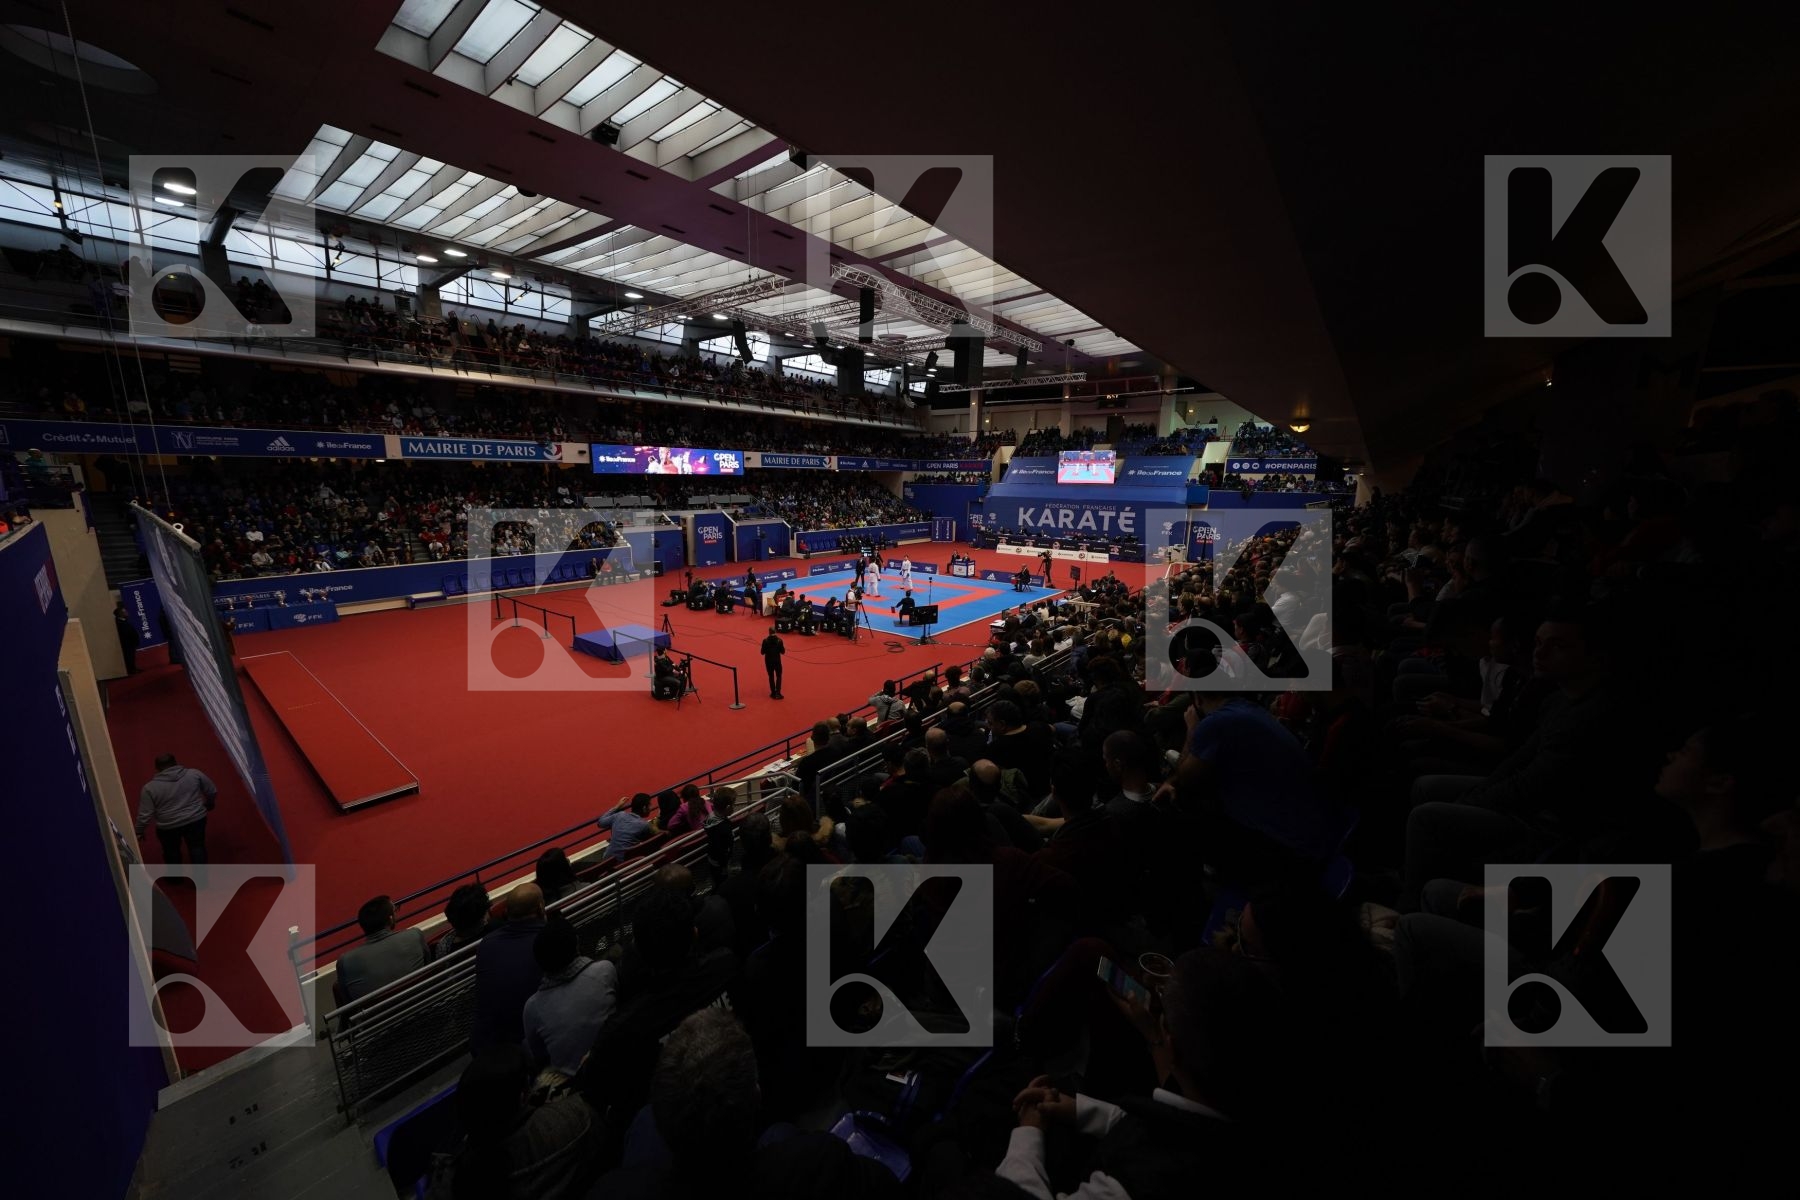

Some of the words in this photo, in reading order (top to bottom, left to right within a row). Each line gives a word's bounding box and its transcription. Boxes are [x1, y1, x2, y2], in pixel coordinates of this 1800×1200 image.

[42, 432, 80, 443] Crédit
[97, 434, 137, 444] Mutuel
[409, 441, 467, 455] MAIRIE
[472, 444, 492, 456] DE
[497, 445, 536, 457] PARIS
[714, 453, 735, 461] OPEN
[764, 456, 790, 465] MAIRIE
[791, 457, 801, 465] DE
[802, 458, 820, 466] PARIS
[720, 461, 740, 469] PARIS
[1018, 506, 1136, 533] KARATÉ
[698, 526, 719, 534] OPEN
